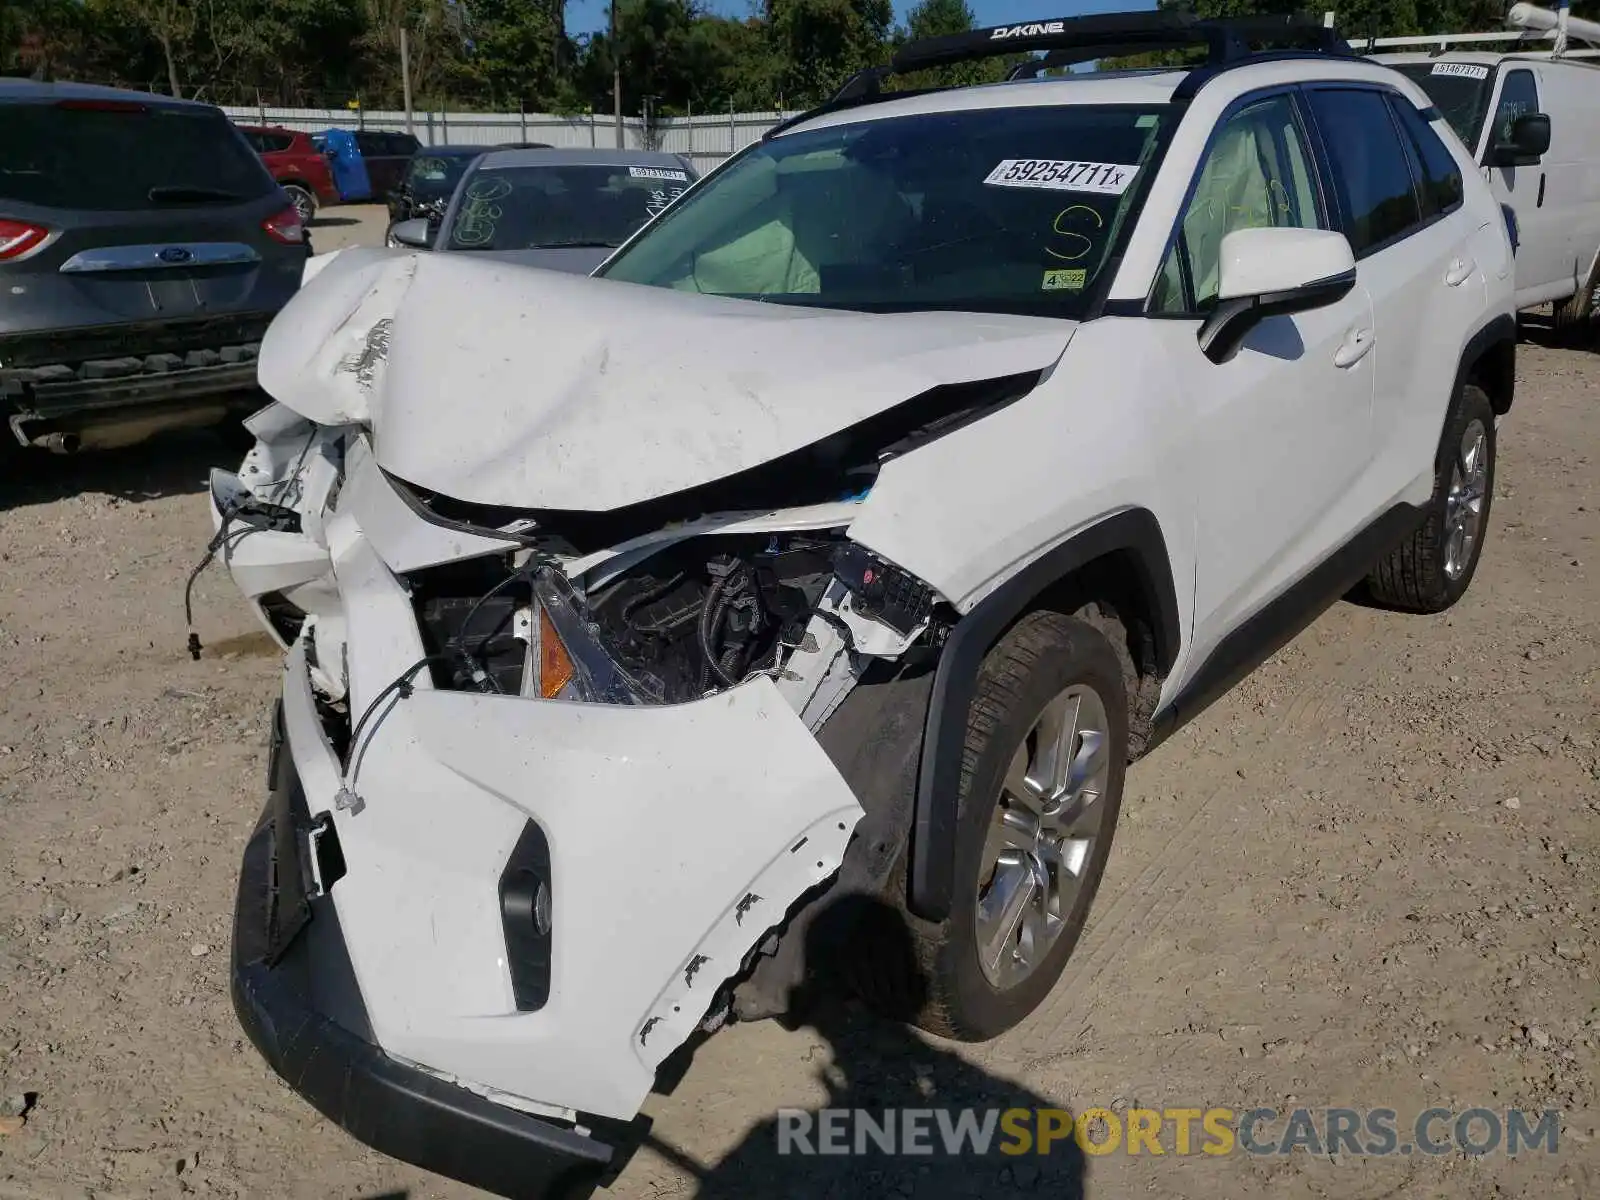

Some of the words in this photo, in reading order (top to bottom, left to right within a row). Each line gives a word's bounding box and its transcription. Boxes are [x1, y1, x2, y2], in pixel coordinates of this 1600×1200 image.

[990, 22, 1065, 39] DAKINE
[1045, 205, 1103, 260] S
[1047, 274, 1056, 286] 4
[1071, 273, 1084, 282] 22
